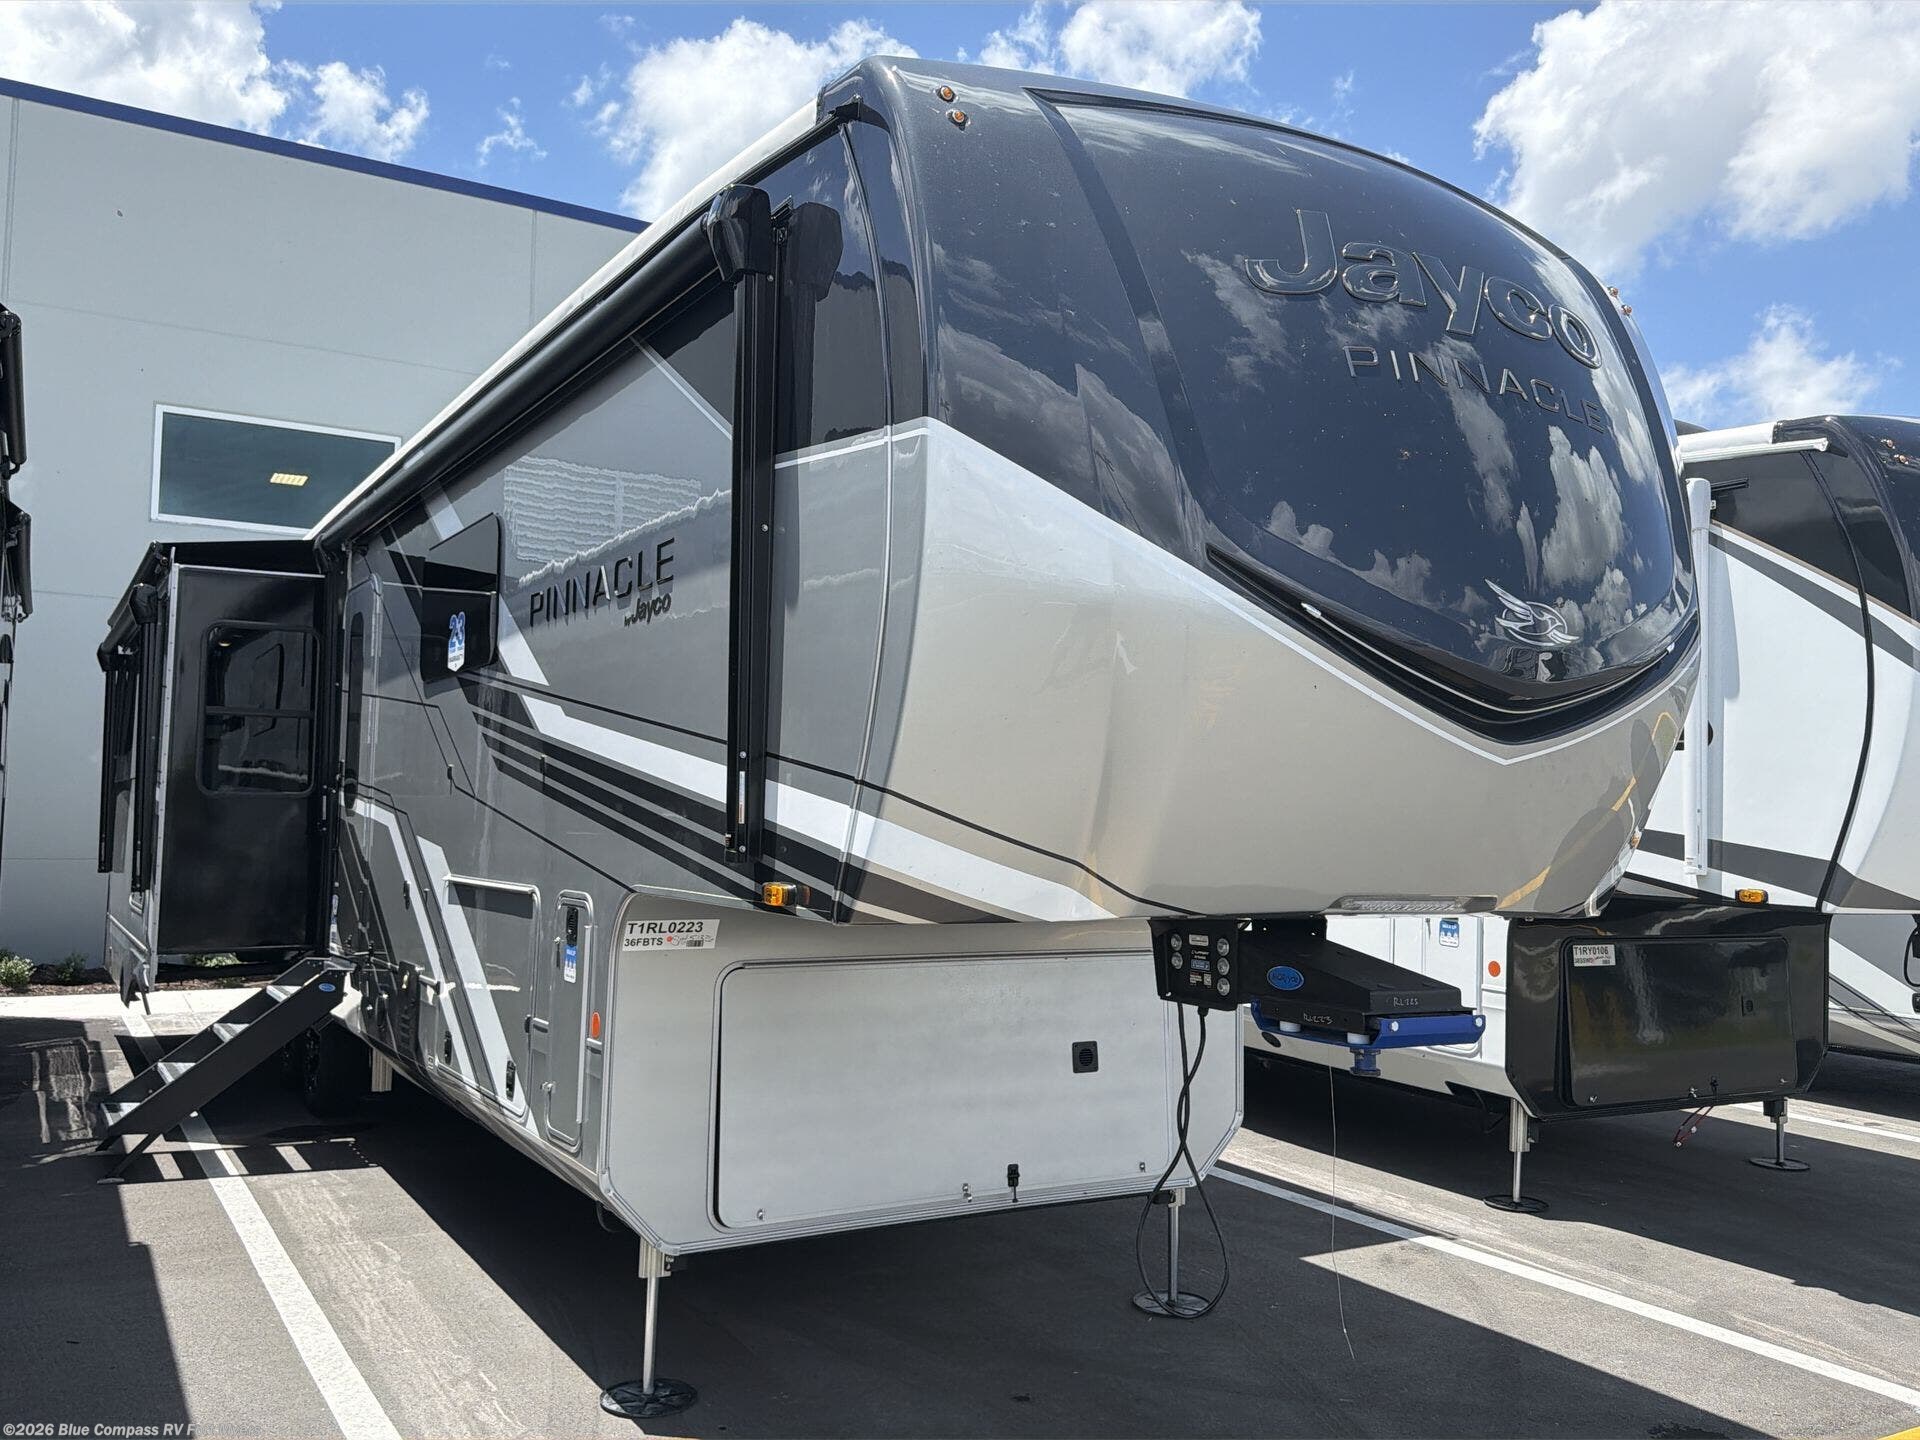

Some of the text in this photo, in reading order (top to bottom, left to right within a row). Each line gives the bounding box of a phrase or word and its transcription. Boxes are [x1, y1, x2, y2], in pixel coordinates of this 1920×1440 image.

[1246, 209, 1602, 369] Jayco
[1343, 345, 1605, 434] PINNACLE
[529, 537, 675, 628] PINNACLE
[632, 593, 672, 625] Jayco
[624, 937, 664, 947] 36FBTS
[627, 921, 704, 935] T1RL0223
